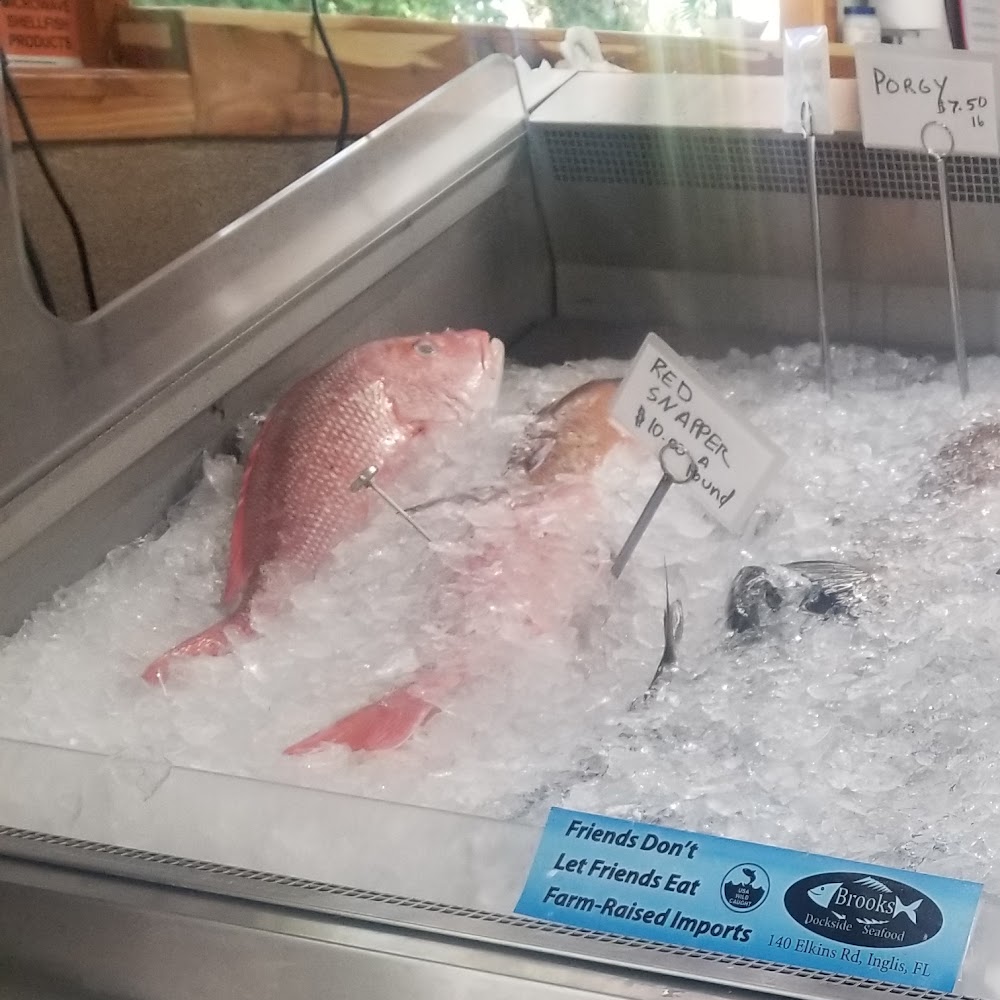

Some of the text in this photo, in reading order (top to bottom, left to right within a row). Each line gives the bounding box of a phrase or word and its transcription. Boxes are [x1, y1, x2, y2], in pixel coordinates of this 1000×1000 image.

[8, 33, 73, 50] PRODUCTS
[873, 67, 948, 99] PORGY
[937, 96, 988, 114] $7.50
[650, 357, 693, 402] RED
[647, 387, 731, 469] SNAPPER
[565, 819, 700, 860] Friends Don't
[553, 852, 702, 897] Let Friends Eat
[542, 885, 753, 943] Farm-Raised Imports
[834, 886, 896, 916] Brooks
[804, 913, 906, 942] Dockside Seafood
[767, 934, 932, 977] 140 Elkins Rd, Inglis, FL
